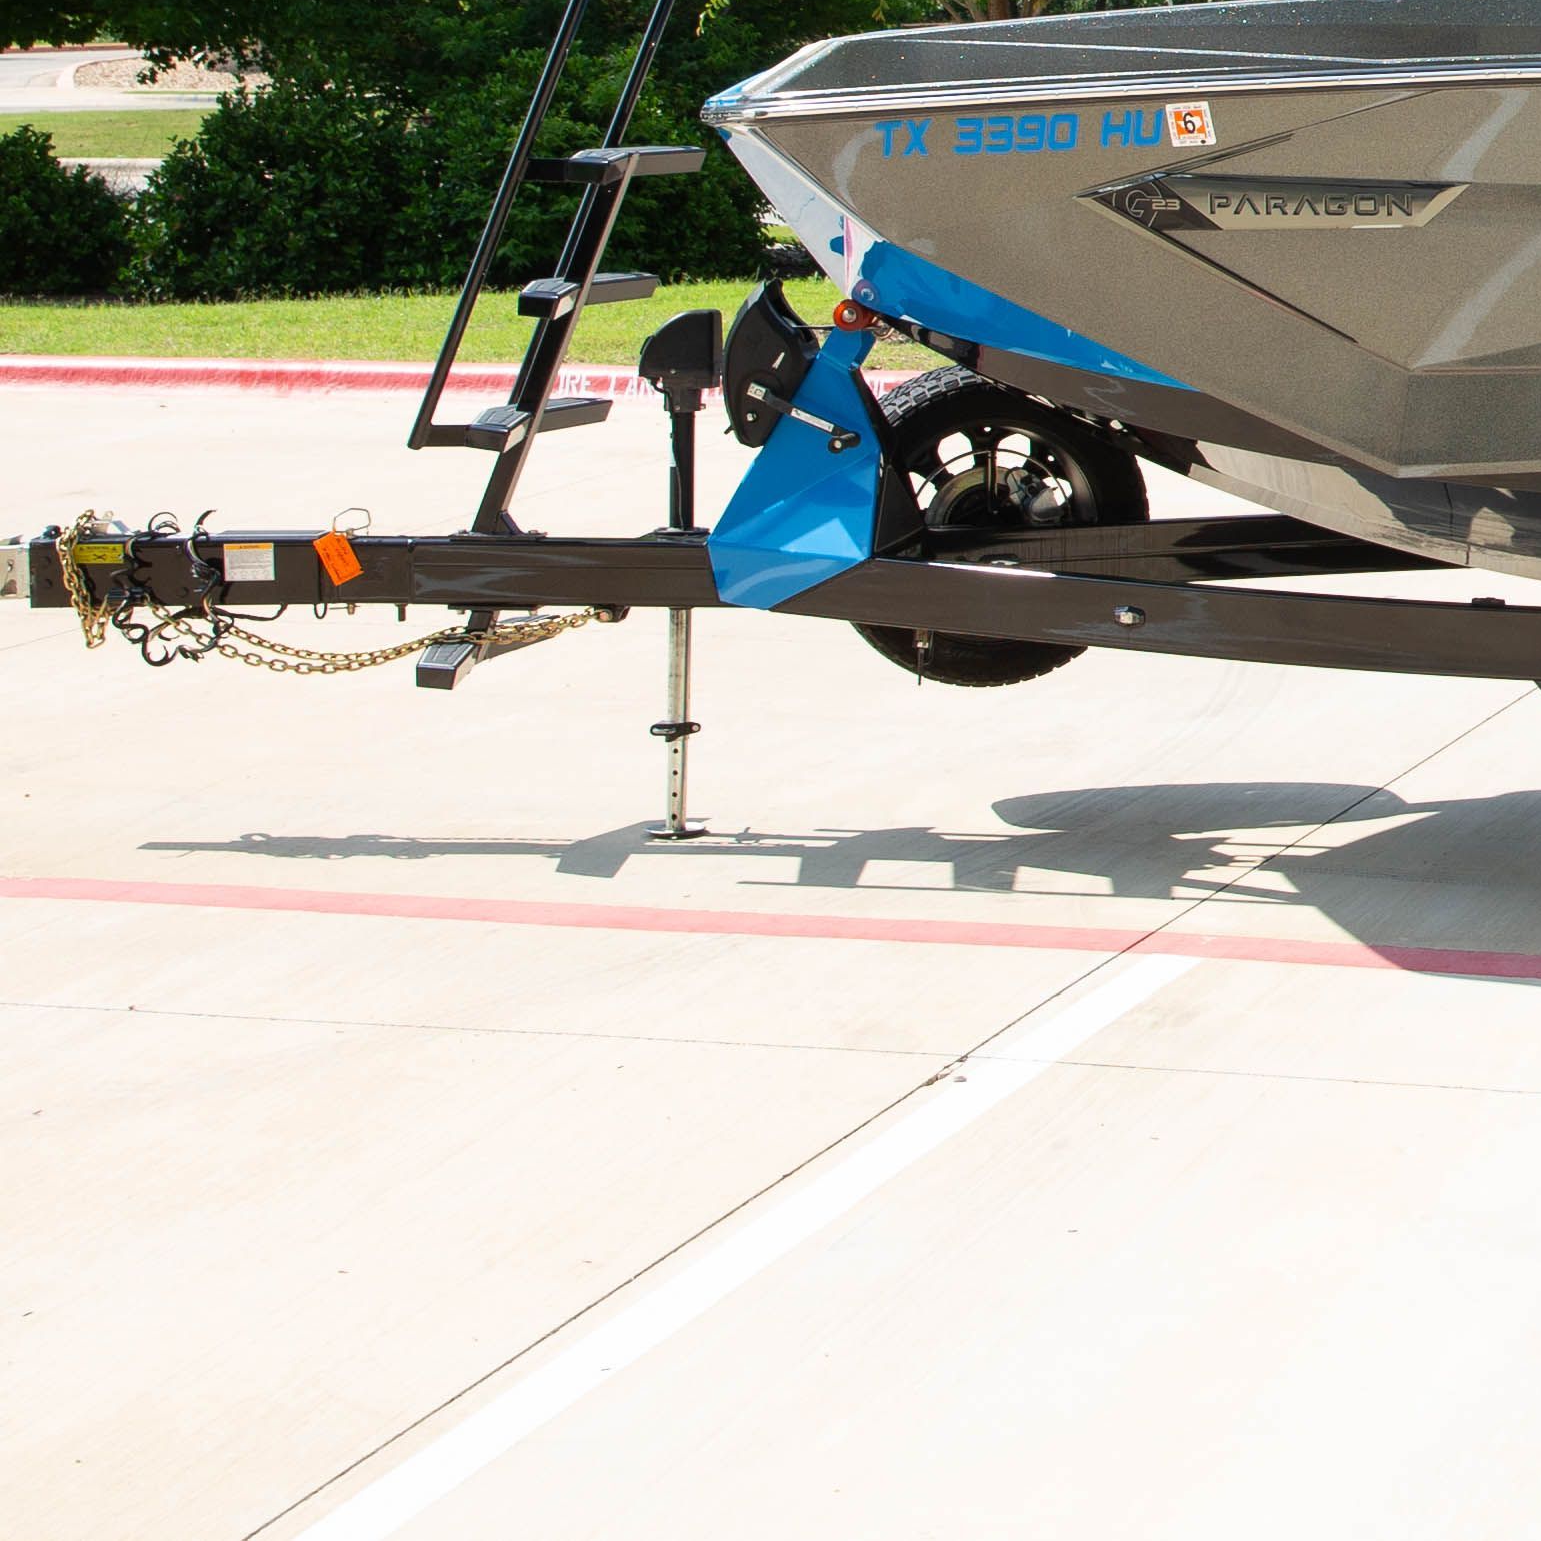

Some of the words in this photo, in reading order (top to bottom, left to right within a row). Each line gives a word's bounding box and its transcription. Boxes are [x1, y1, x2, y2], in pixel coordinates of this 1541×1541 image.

[874, 119, 932, 158] TX
[954, 113, 1079, 155] 3390
[1100, 109, 1165, 148] HU
[1208, 192, 1413, 217] PARAGON
